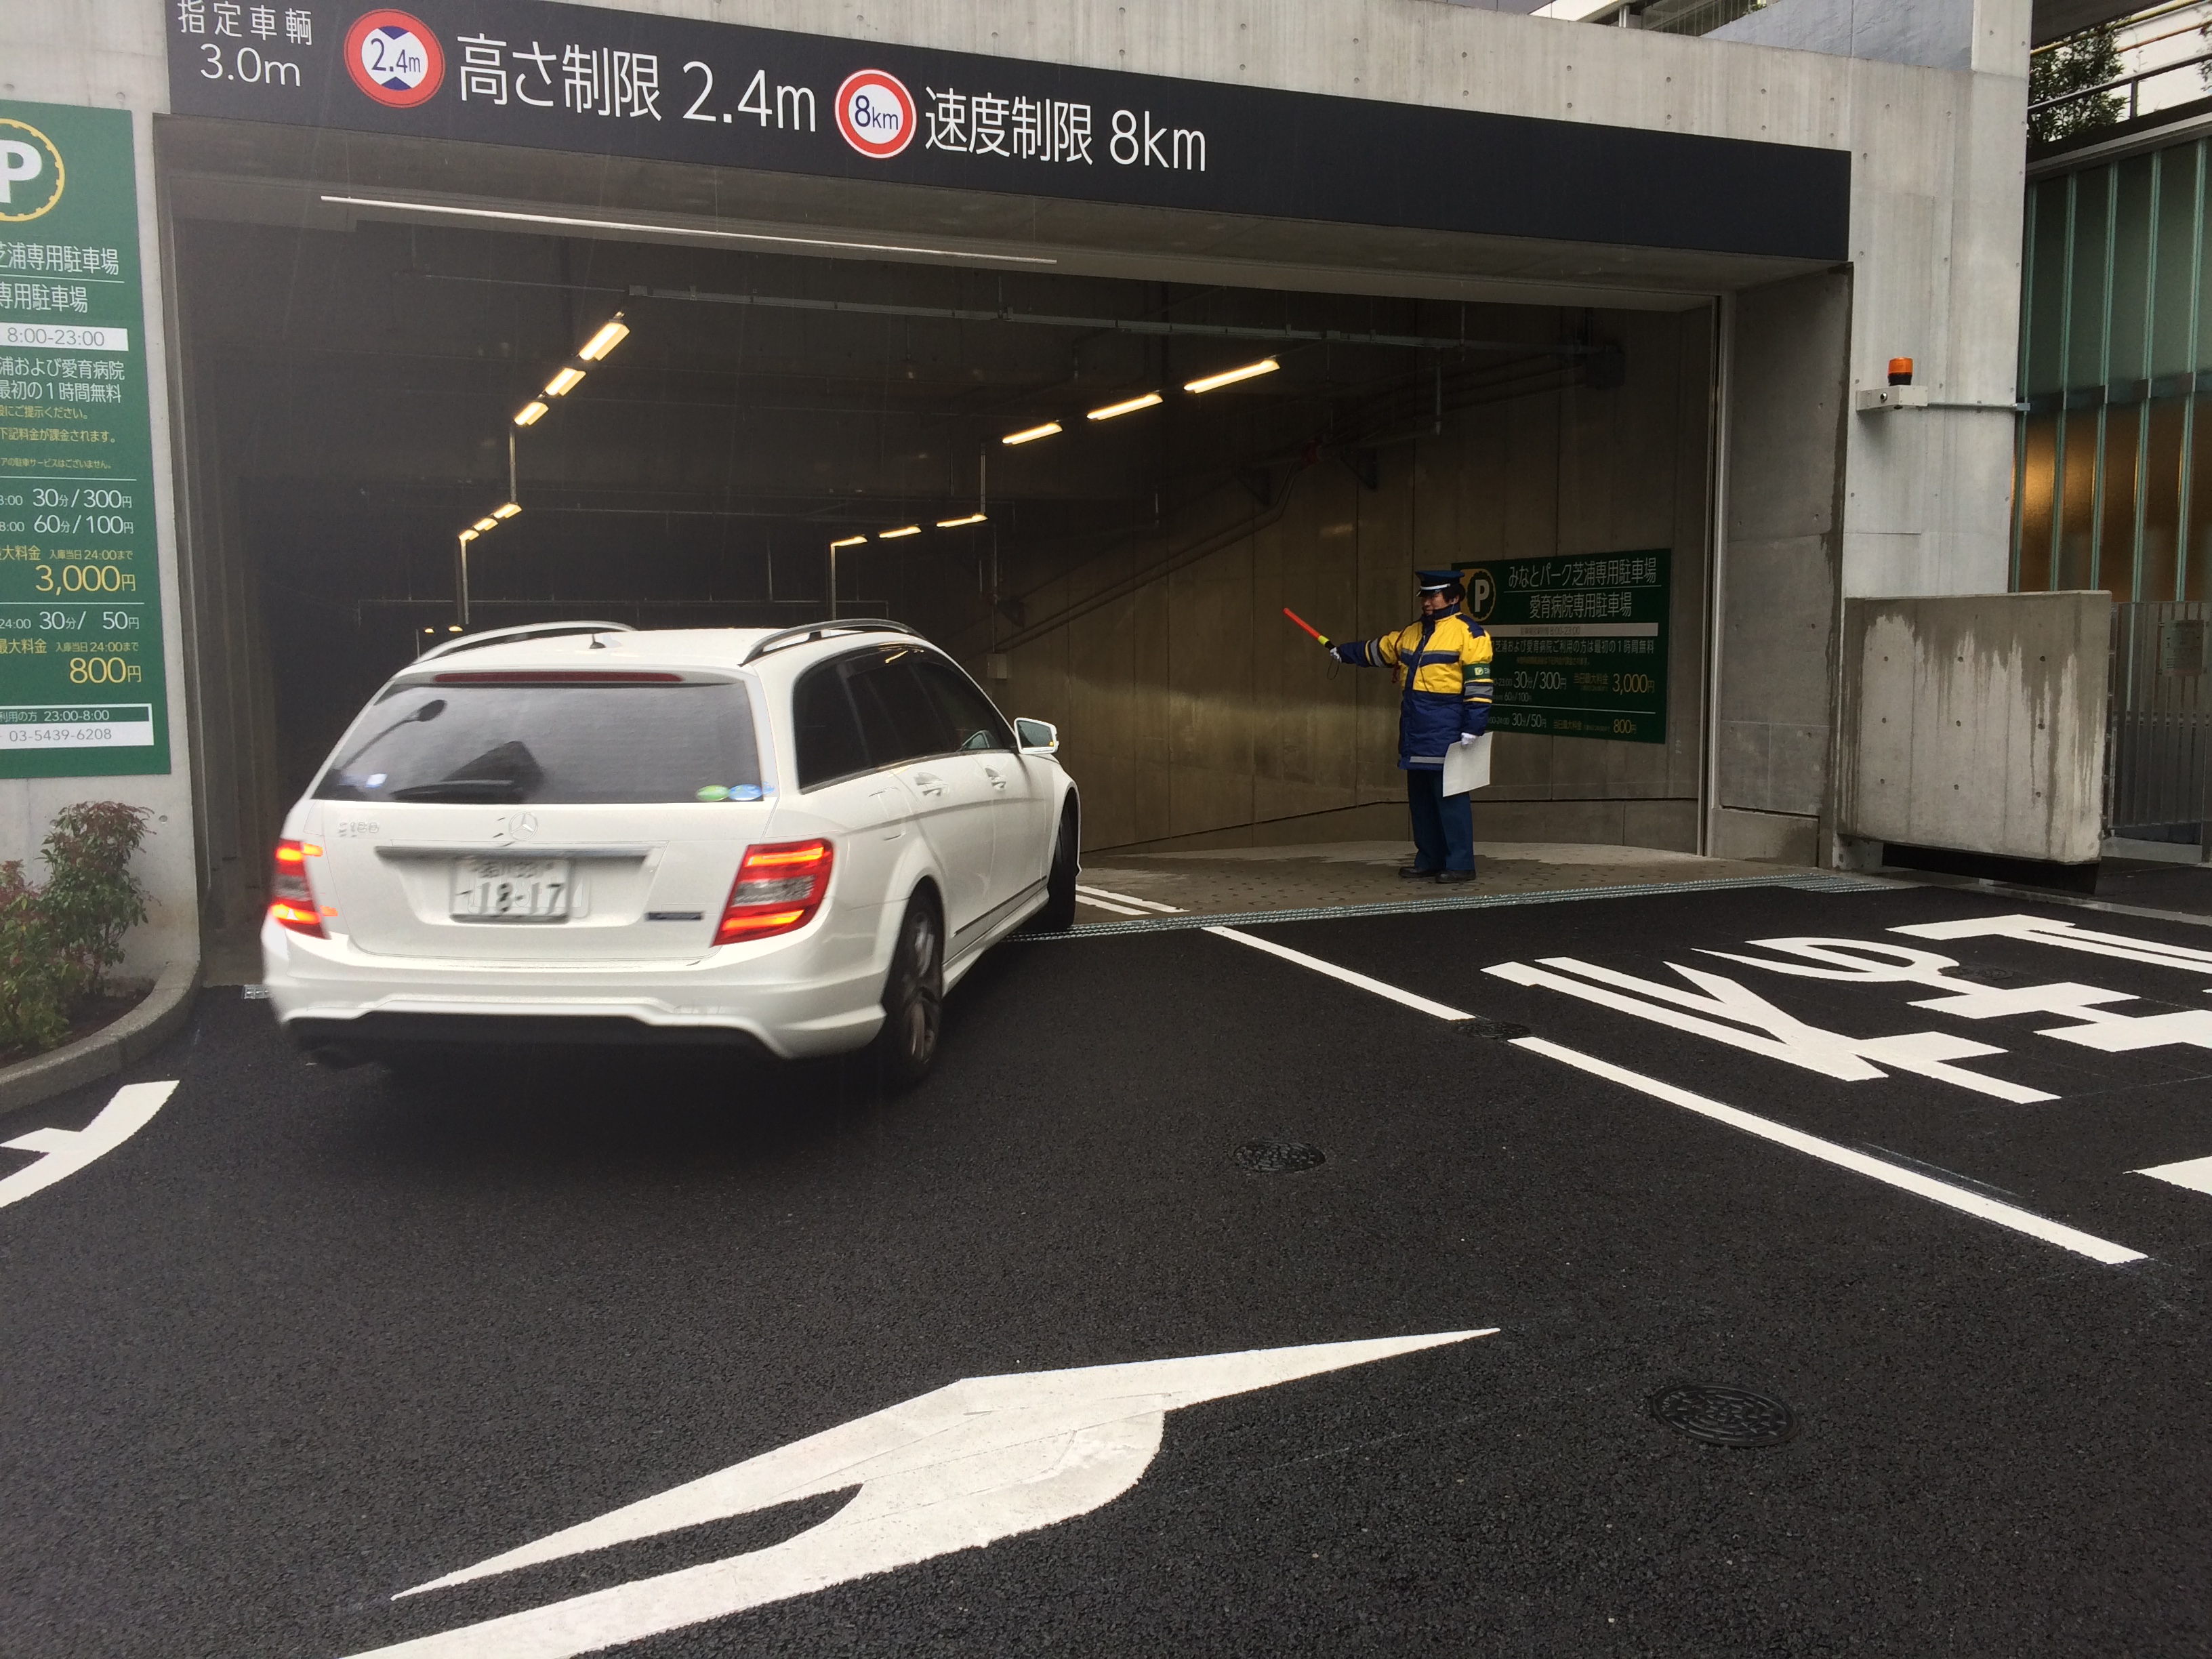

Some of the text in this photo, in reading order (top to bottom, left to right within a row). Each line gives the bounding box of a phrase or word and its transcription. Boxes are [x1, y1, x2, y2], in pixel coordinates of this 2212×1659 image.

[199, 43, 302, 87] 3.0m
[370, 38, 422, 75] 2.4m
[457, 33, 817, 132] 高さ制限 2.4m
[854, 94, 900, 131] 8km
[924, 86, 1207, 171] 速度制限 8km
[7, 327, 105, 346] 8:00-23:00
[0, 545, 41, 560] 大料金
[35, 564, 136, 596] 3,000円
[1508, 557, 1657, 588] みなとパーク芝浦専用駐車場
[1529, 592, 1632, 619] 愛育病院専用駐車場
[69, 657, 142, 683] 800円
[9, 729, 112, 742] 03-5439-6208
